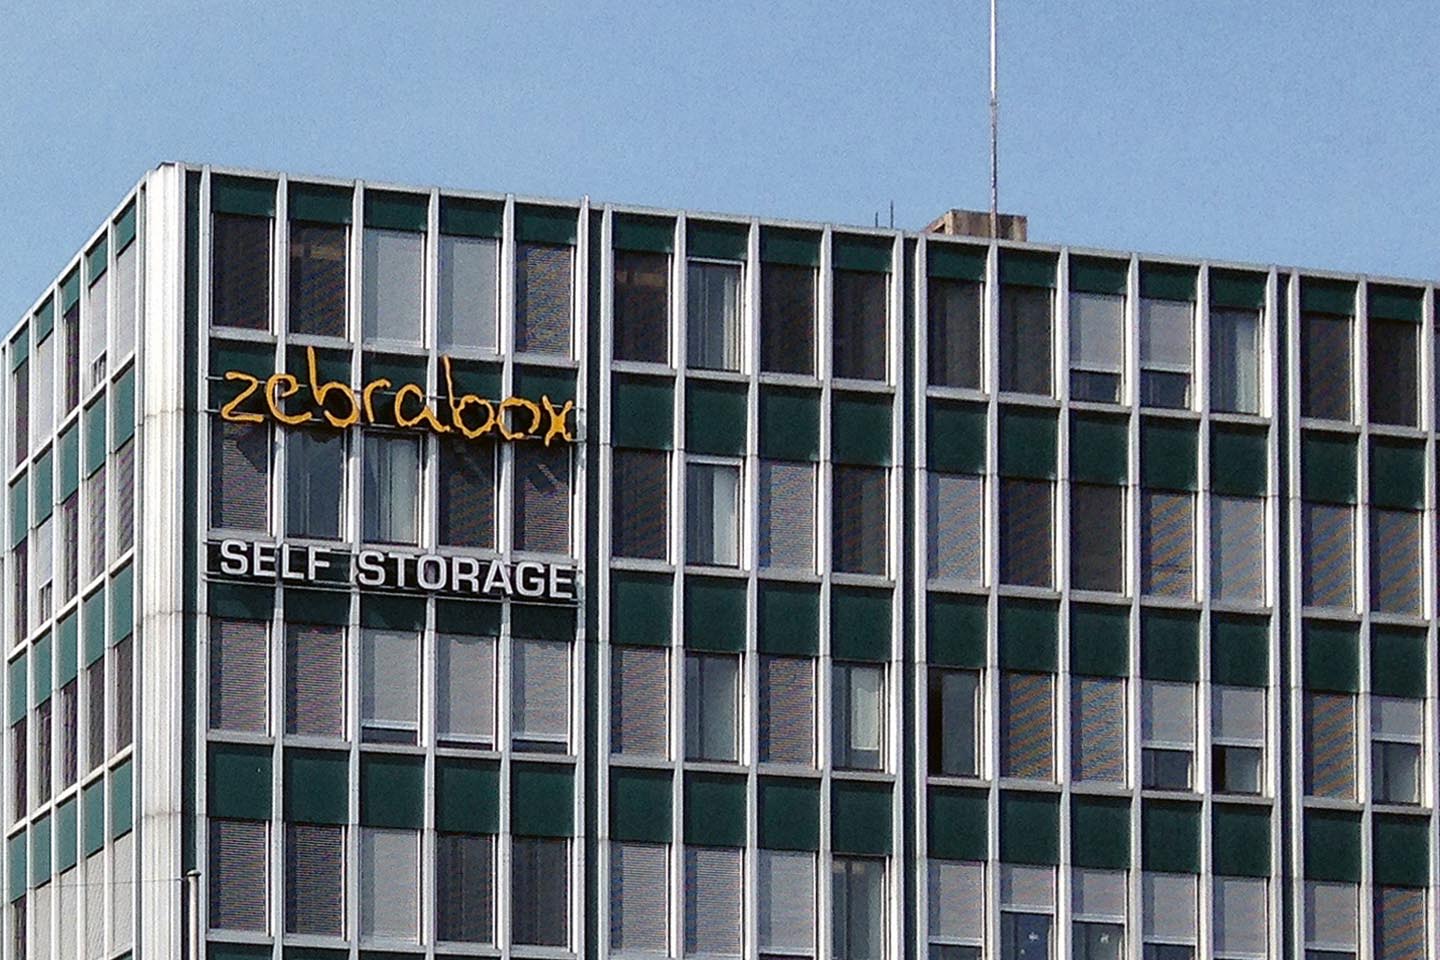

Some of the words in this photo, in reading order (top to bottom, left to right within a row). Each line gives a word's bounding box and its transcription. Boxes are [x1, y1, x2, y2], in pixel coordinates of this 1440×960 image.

[220, 346, 573, 446] zebrabox
[220, 539, 332, 581] SELF
[357, 550, 574, 599] STORAGE
